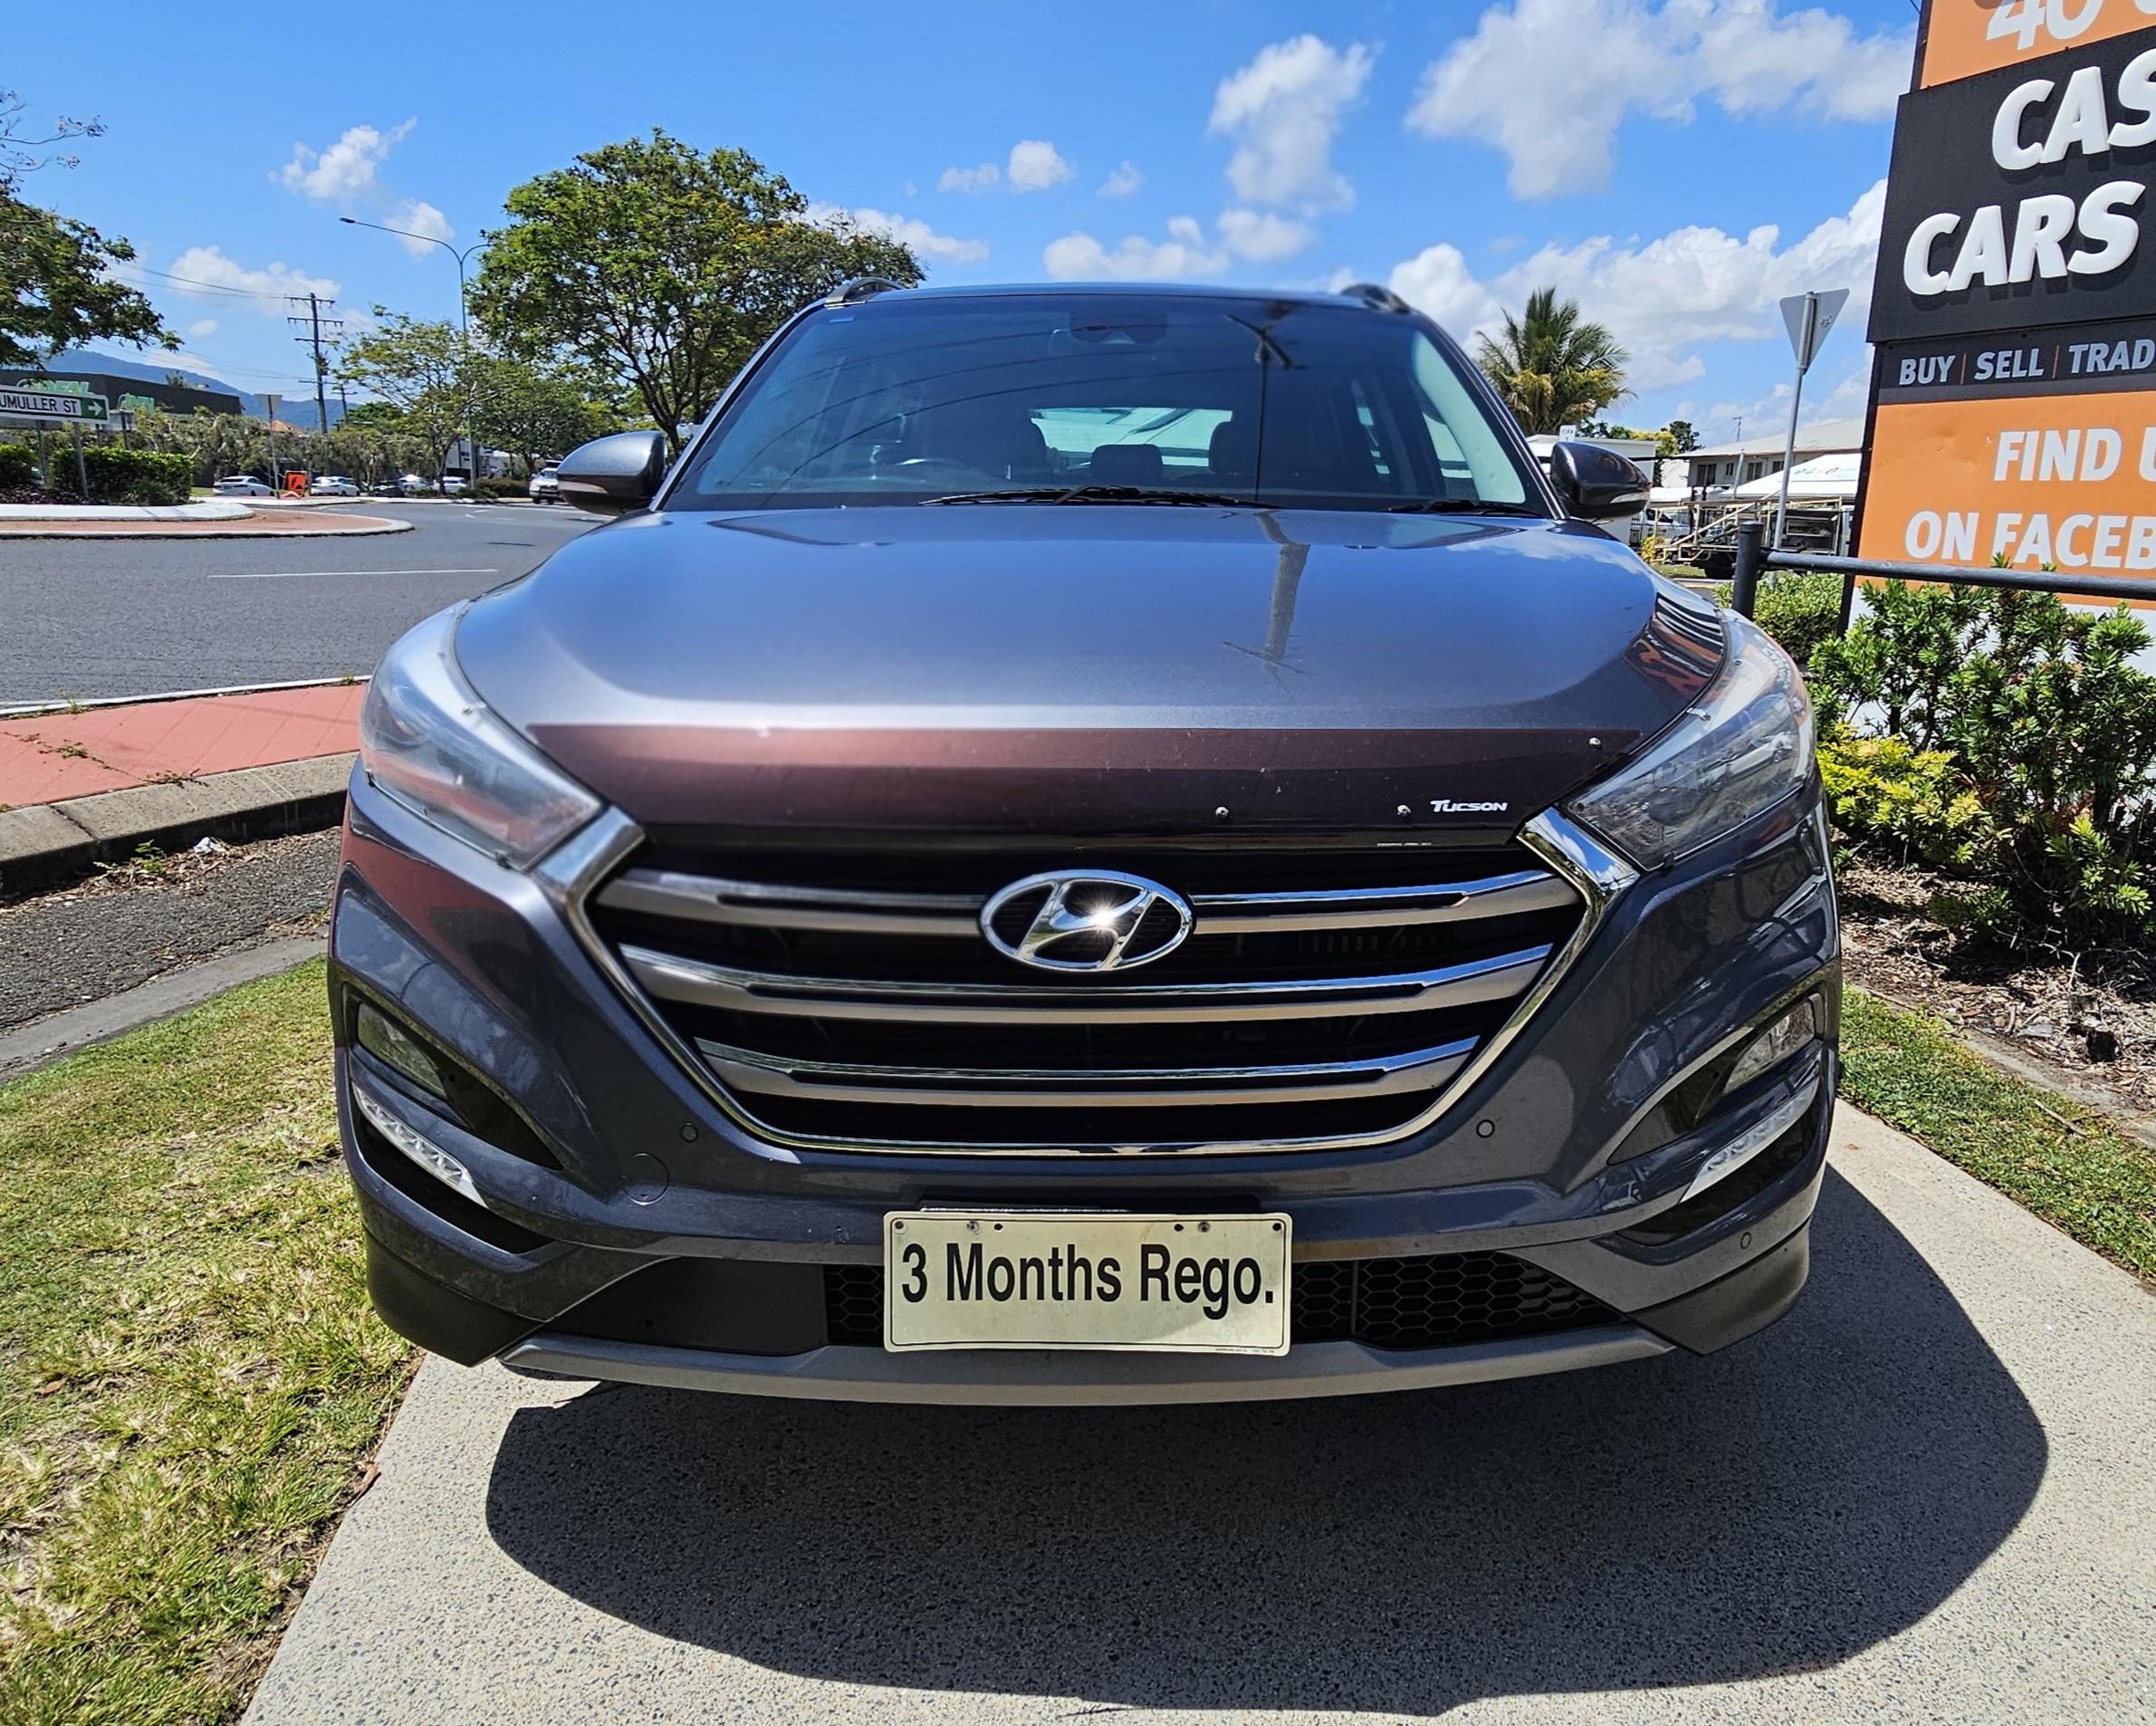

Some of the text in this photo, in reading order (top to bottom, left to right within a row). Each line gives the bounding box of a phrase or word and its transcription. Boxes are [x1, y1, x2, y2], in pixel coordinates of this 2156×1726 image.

[1903, 180, 2146, 295] CARS
[1899, 339, 2156, 386] BUY SELL TRAD
[63, 399, 78, 413] ST
[1993, 427, 2122, 482] FIND
[1905, 510, 1980, 561] ON
[901, 1242, 1275, 1321] 3 Months Rego.
